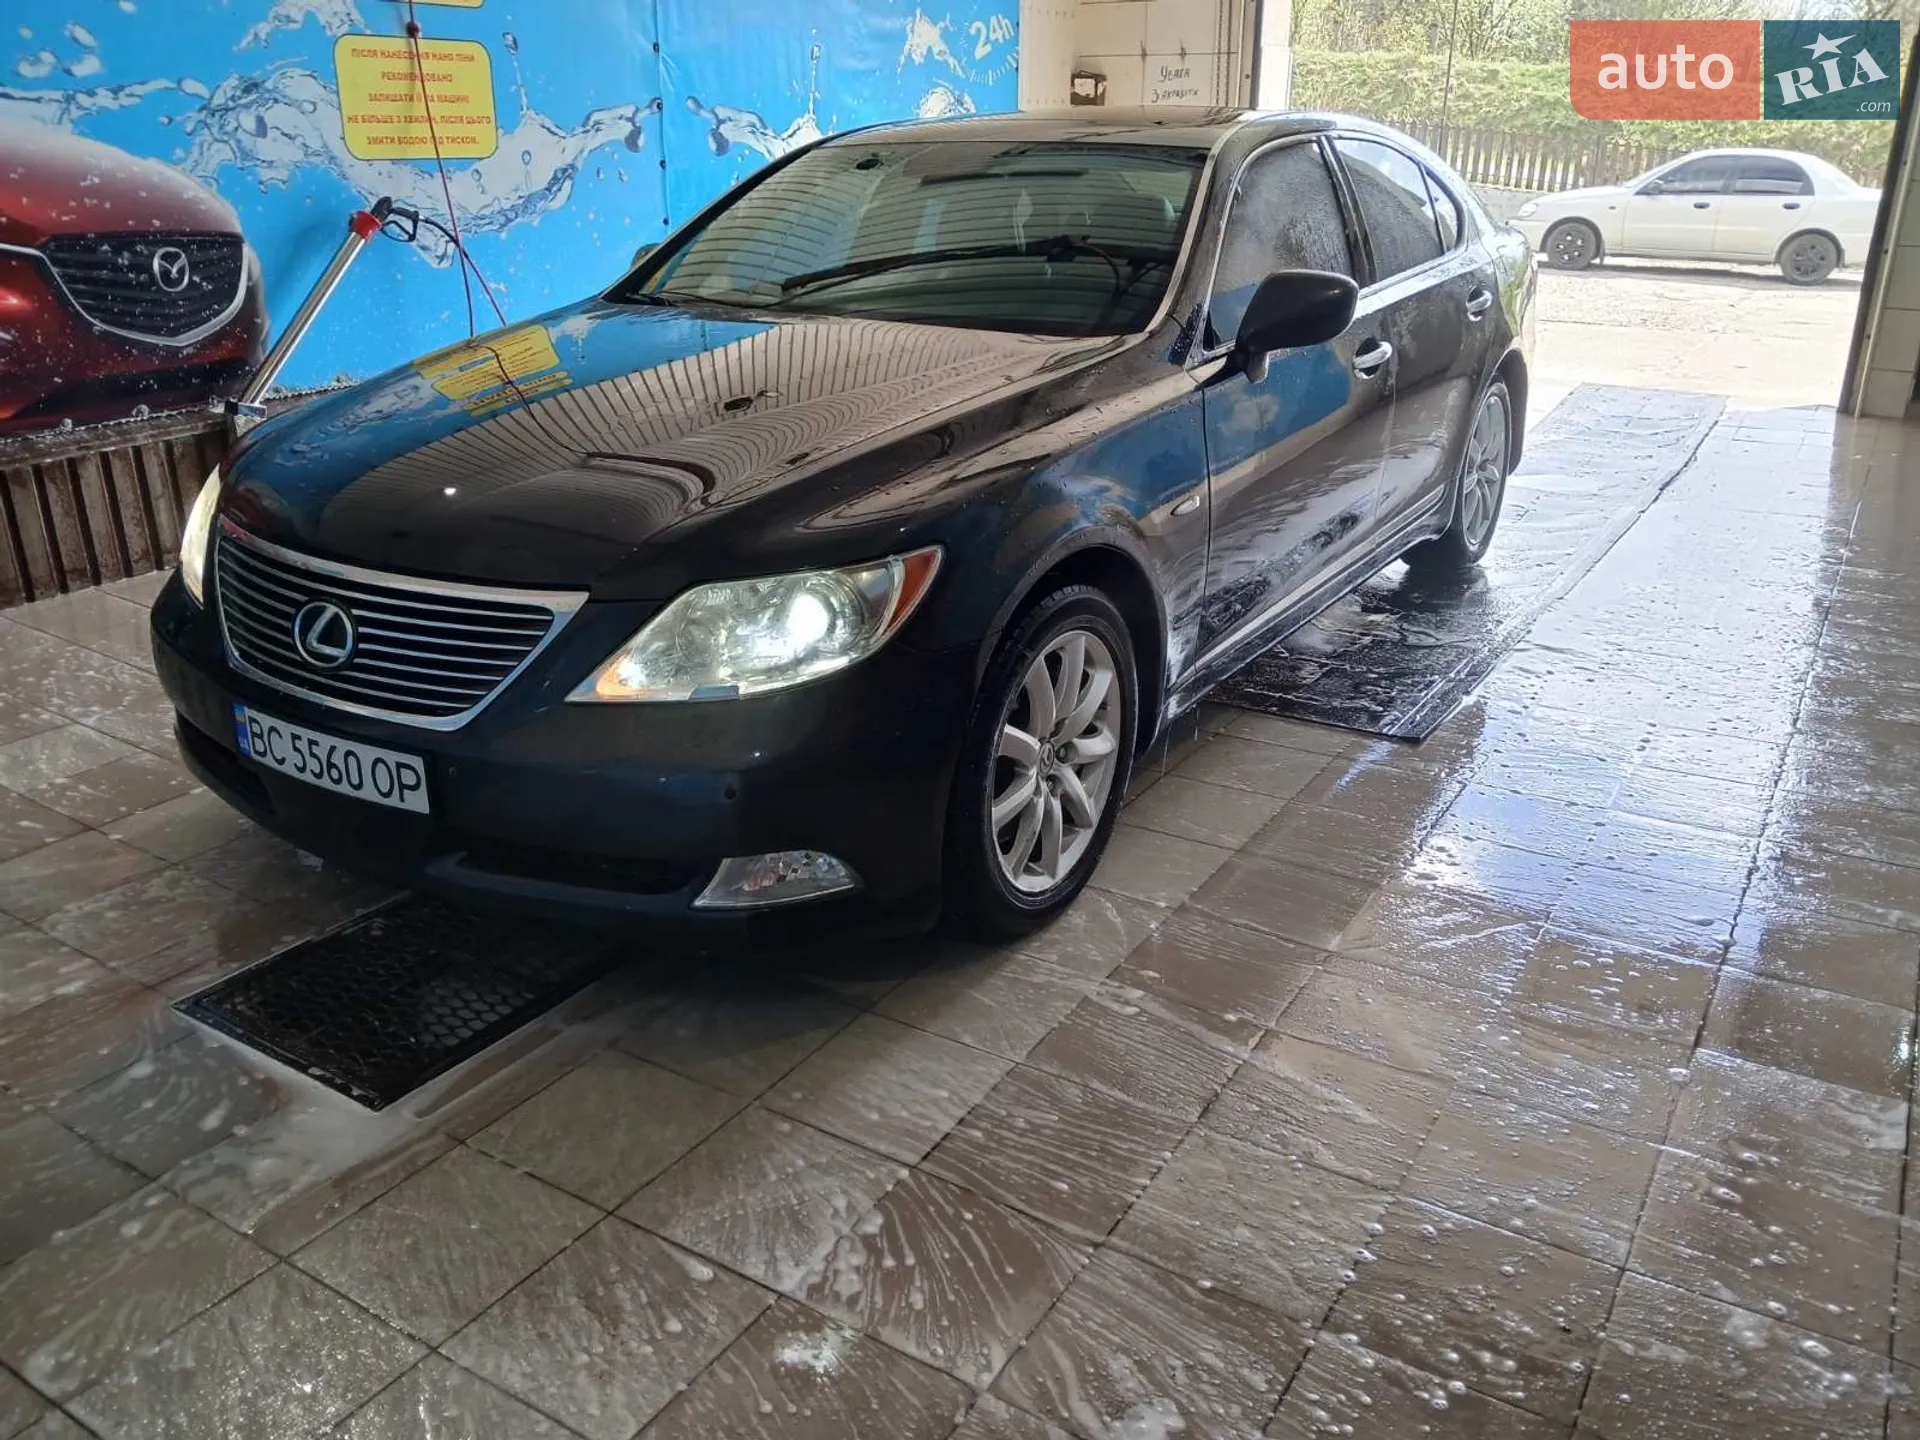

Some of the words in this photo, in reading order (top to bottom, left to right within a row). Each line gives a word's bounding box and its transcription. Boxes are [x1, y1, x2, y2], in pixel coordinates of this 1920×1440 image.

[968, 13, 1015, 60] 24h
[381, 71, 452, 82] РЕКОМЕНОВАНО
[347, 115, 360, 124] НЕ
[248, 714, 286, 767] BC
[291, 731, 364, 792] 5560
[370, 757, 422, 803] OP
